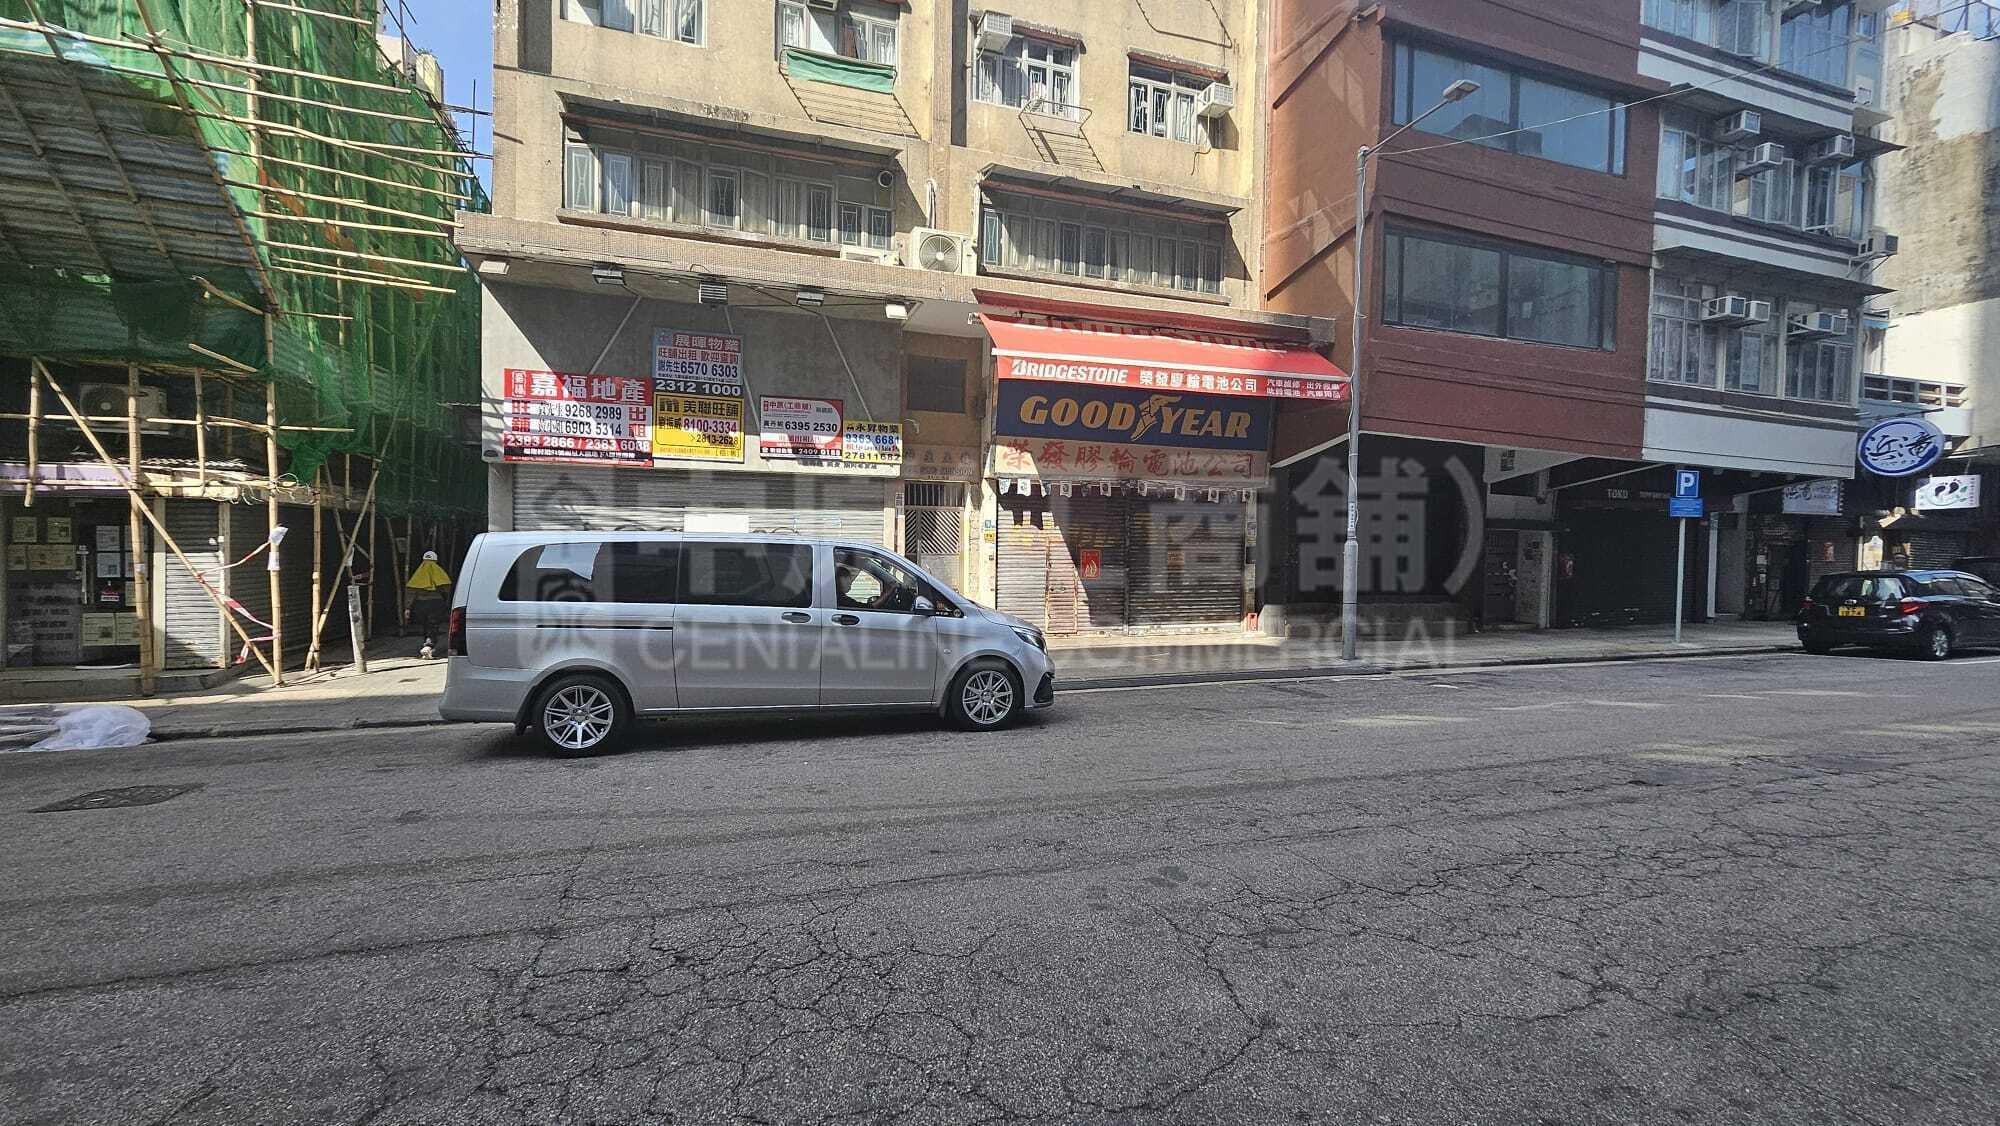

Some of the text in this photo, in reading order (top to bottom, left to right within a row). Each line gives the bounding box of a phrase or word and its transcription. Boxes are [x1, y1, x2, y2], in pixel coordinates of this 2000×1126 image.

[680, 361, 708, 375] 6570
[712, 364, 738, 378] 6303
[1011, 359, 1129, 384] BRIDGESTONE
[530, 373, 646, 402] 嘉福地產
[655, 380, 741, 396] 2312 1000
[565, 404, 592, 417] 9268
[595, 406, 622, 420] 2989
[683, 400, 739, 417] 美聯旺舖
[1020, 394, 1250, 438] GOODYEAR
[565, 420, 592, 434] 6903
[596, 422, 622, 436] 5314
[629, 406, 647, 438] 出租
[683, 418, 737, 433] 8100-3334
[785, 421, 811, 431] 6395
[813, 423, 838, 432] 2530
[507, 433, 540, 447] 2383
[542, 434, 575, 448] 2866
[697, 434, 739, 448] 2813-2628
[845, 434, 900, 445] 9363 6681
[1002, 439, 1256, 479] 榮發膠輪電池公司
[1680, 472, 1695, 495] P
